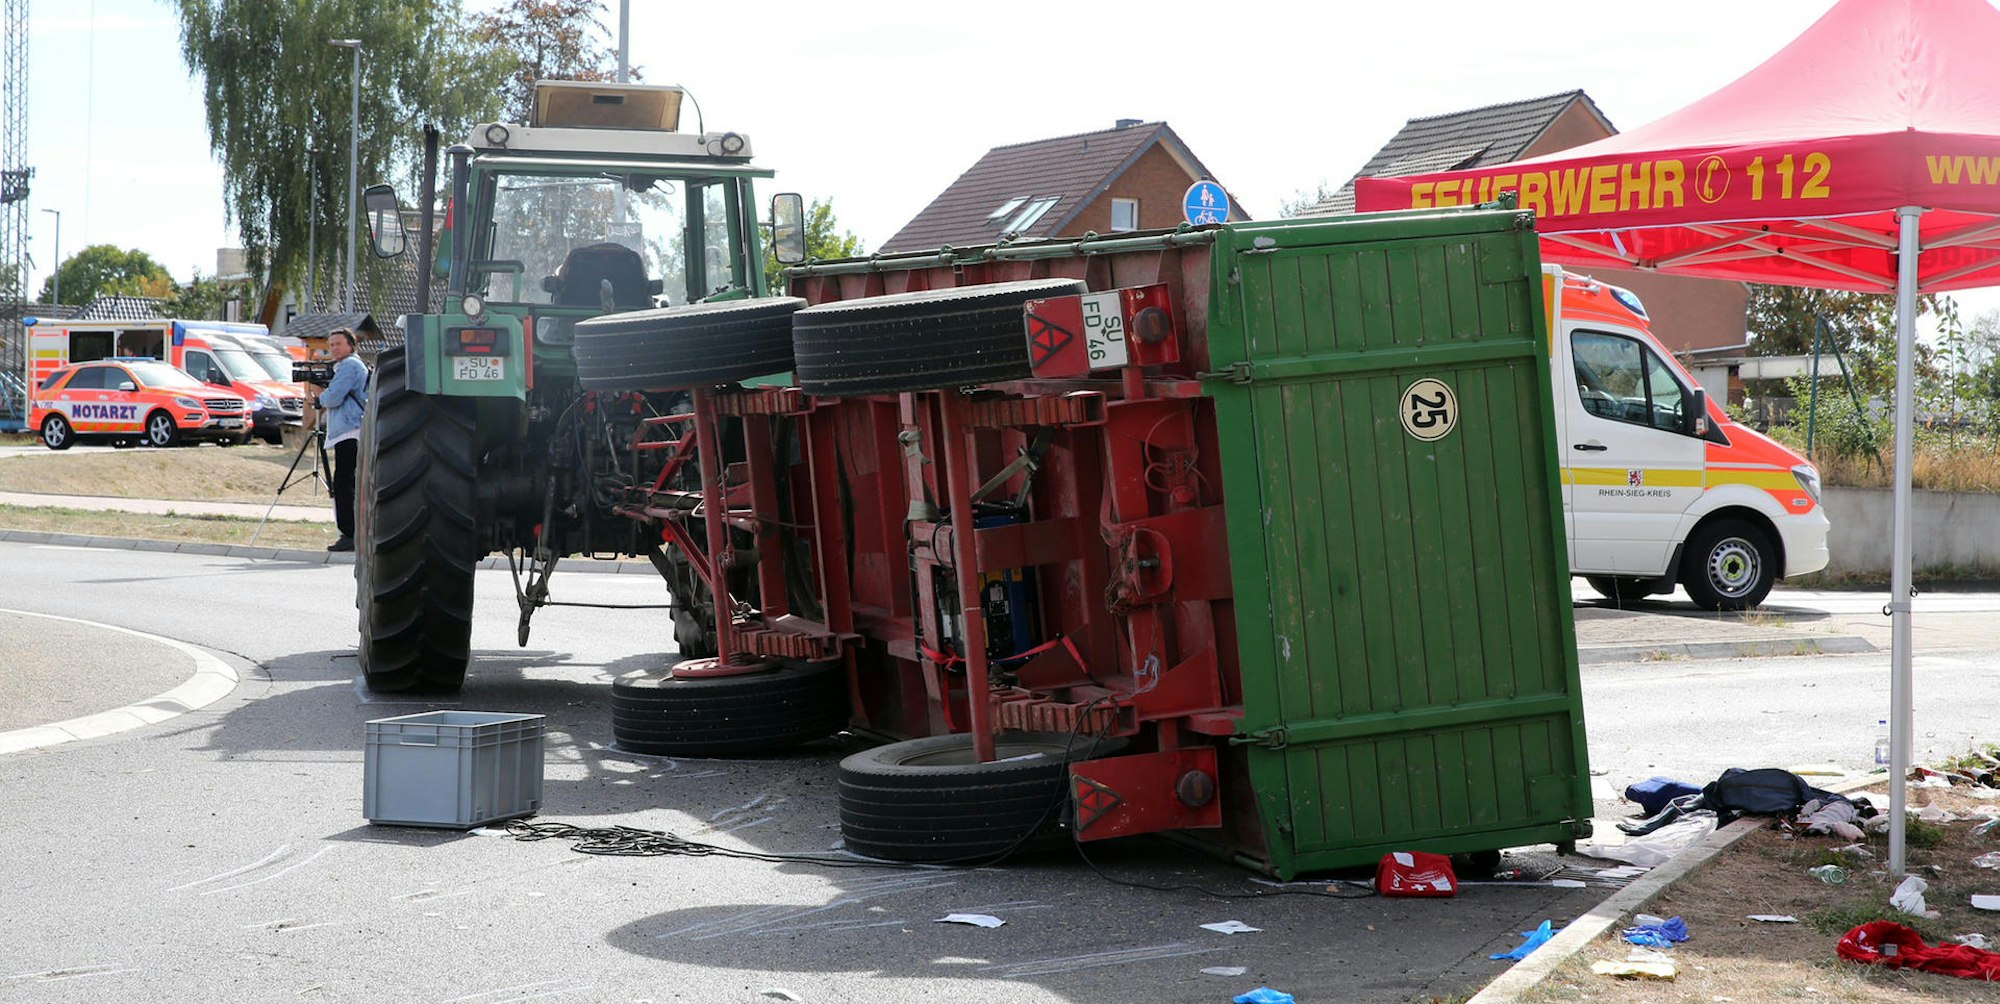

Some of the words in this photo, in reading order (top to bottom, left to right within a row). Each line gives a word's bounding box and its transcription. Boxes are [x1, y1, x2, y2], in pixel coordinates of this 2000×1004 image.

[1746, 152, 1832, 201] 112
[1083, 301, 1101, 328] FD
[1104, 316, 1123, 343] SU
[1088, 339, 1106, 360] 46
[469, 357, 488, 368] SU
[460, 369, 478, 379] FD
[484, 369, 499, 379] 46
[72, 404, 137, 419] NOTARZT
[1411, 391, 1449, 428] 25
[1598, 489, 1672, 498] RHEIN-SIEG-KREIS
